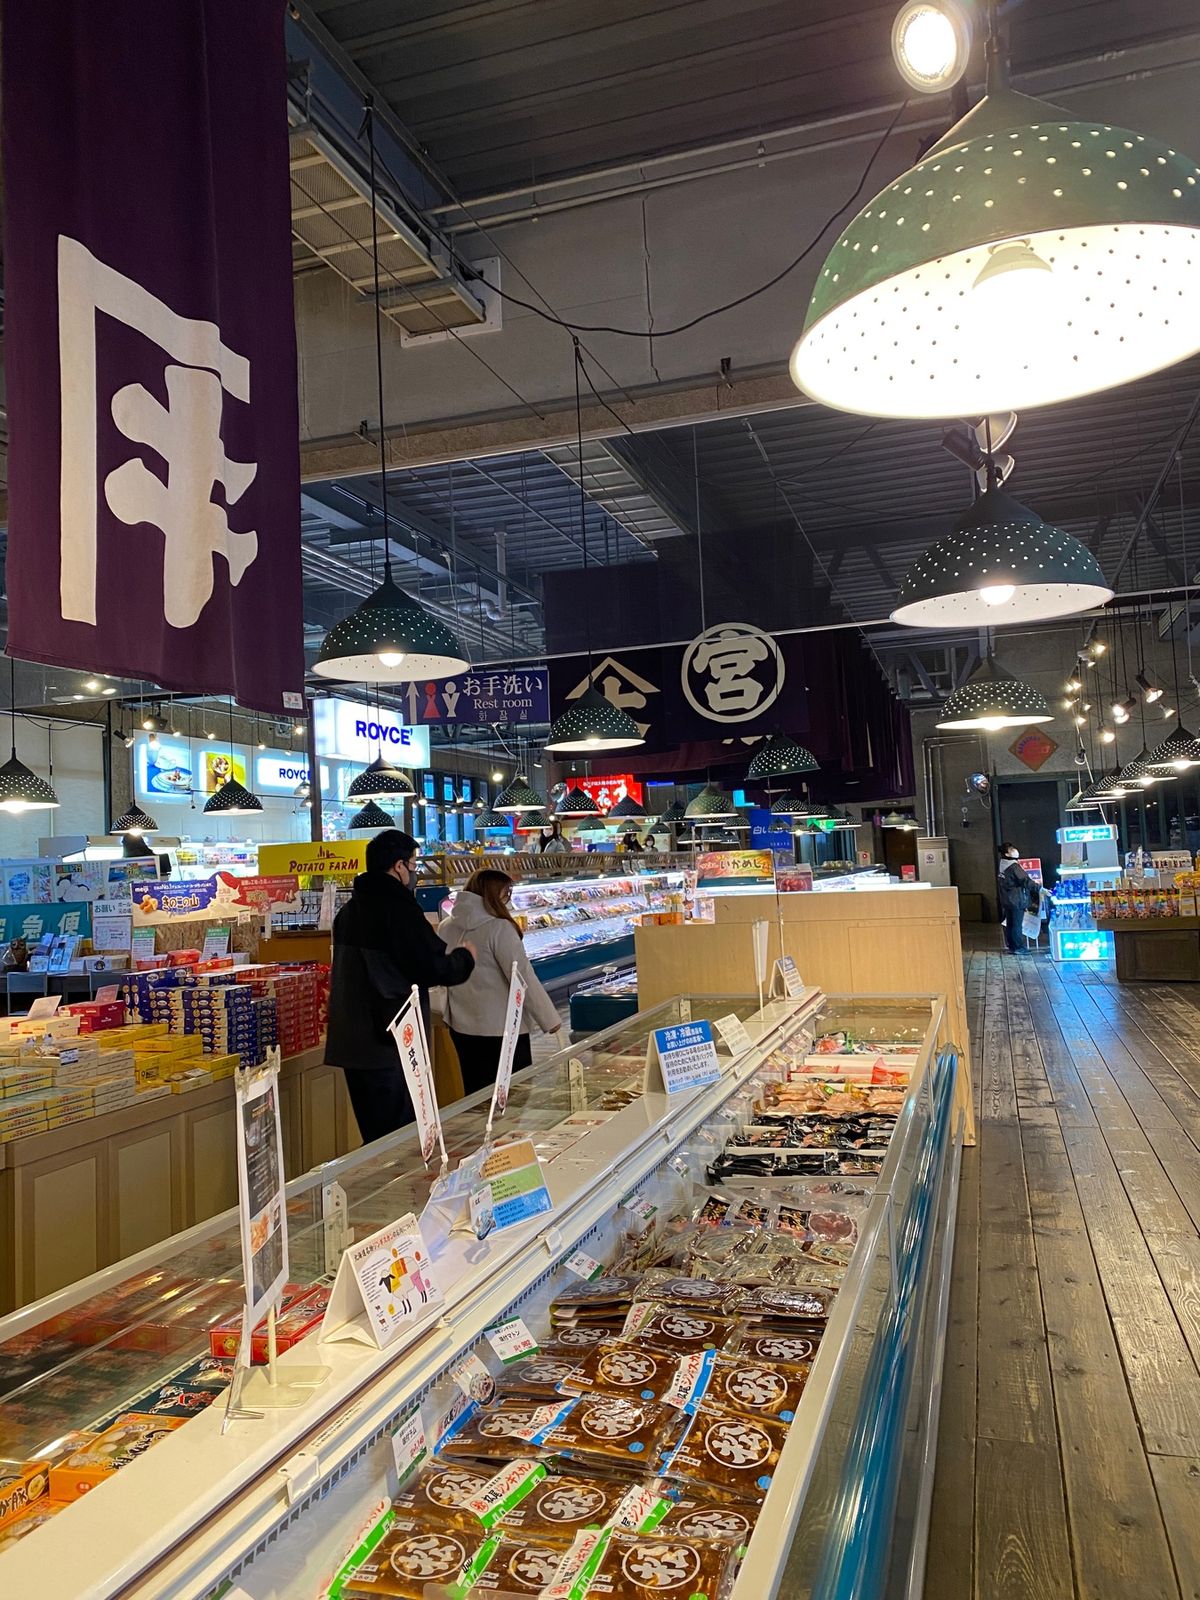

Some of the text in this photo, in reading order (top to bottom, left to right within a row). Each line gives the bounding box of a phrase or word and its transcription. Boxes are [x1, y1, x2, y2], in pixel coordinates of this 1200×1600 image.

[693, 629, 768, 712] 宮
[462, 674, 543, 696] お手洗い
[473, 697, 533, 709] Rest room
[289, 857, 359, 873] POTATO FARM
[720, 857, 762, 870] いかめし
[134, 885, 149, 894] meiji
[162, 893, 199, 910] きのこの山
